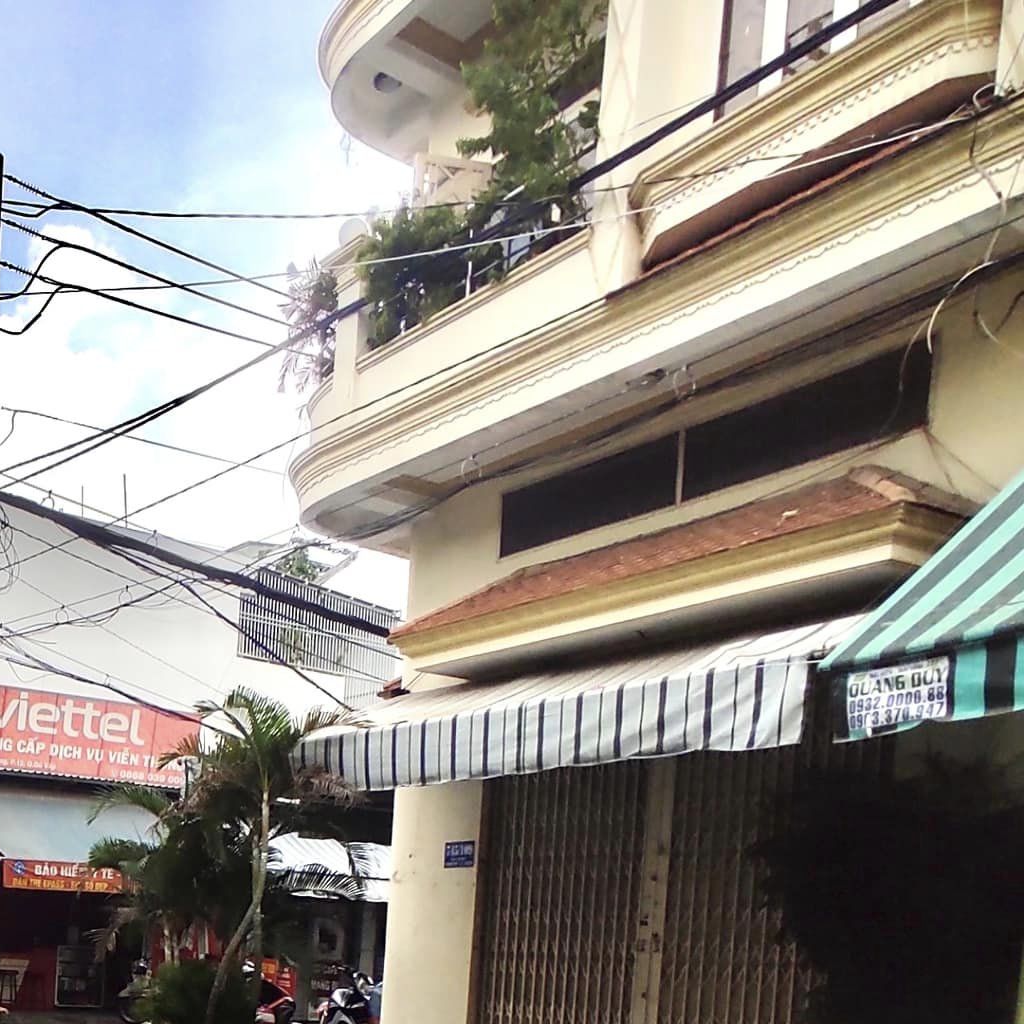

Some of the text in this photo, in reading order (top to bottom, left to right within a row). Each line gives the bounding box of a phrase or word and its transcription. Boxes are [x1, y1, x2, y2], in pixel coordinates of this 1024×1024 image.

[849, 675, 905, 698] QUANG
[911, 668, 943, 688] DUY
[849, 686, 945, 714] 0932.0000.88
[16, 735, 46, 755] CẤP
[50, 742, 82, 762] DỊCH
[86, 746, 103, 764] VỤ
[108, 747, 138, 766] VIỄN
[34, 862, 58, 876] BẢO
